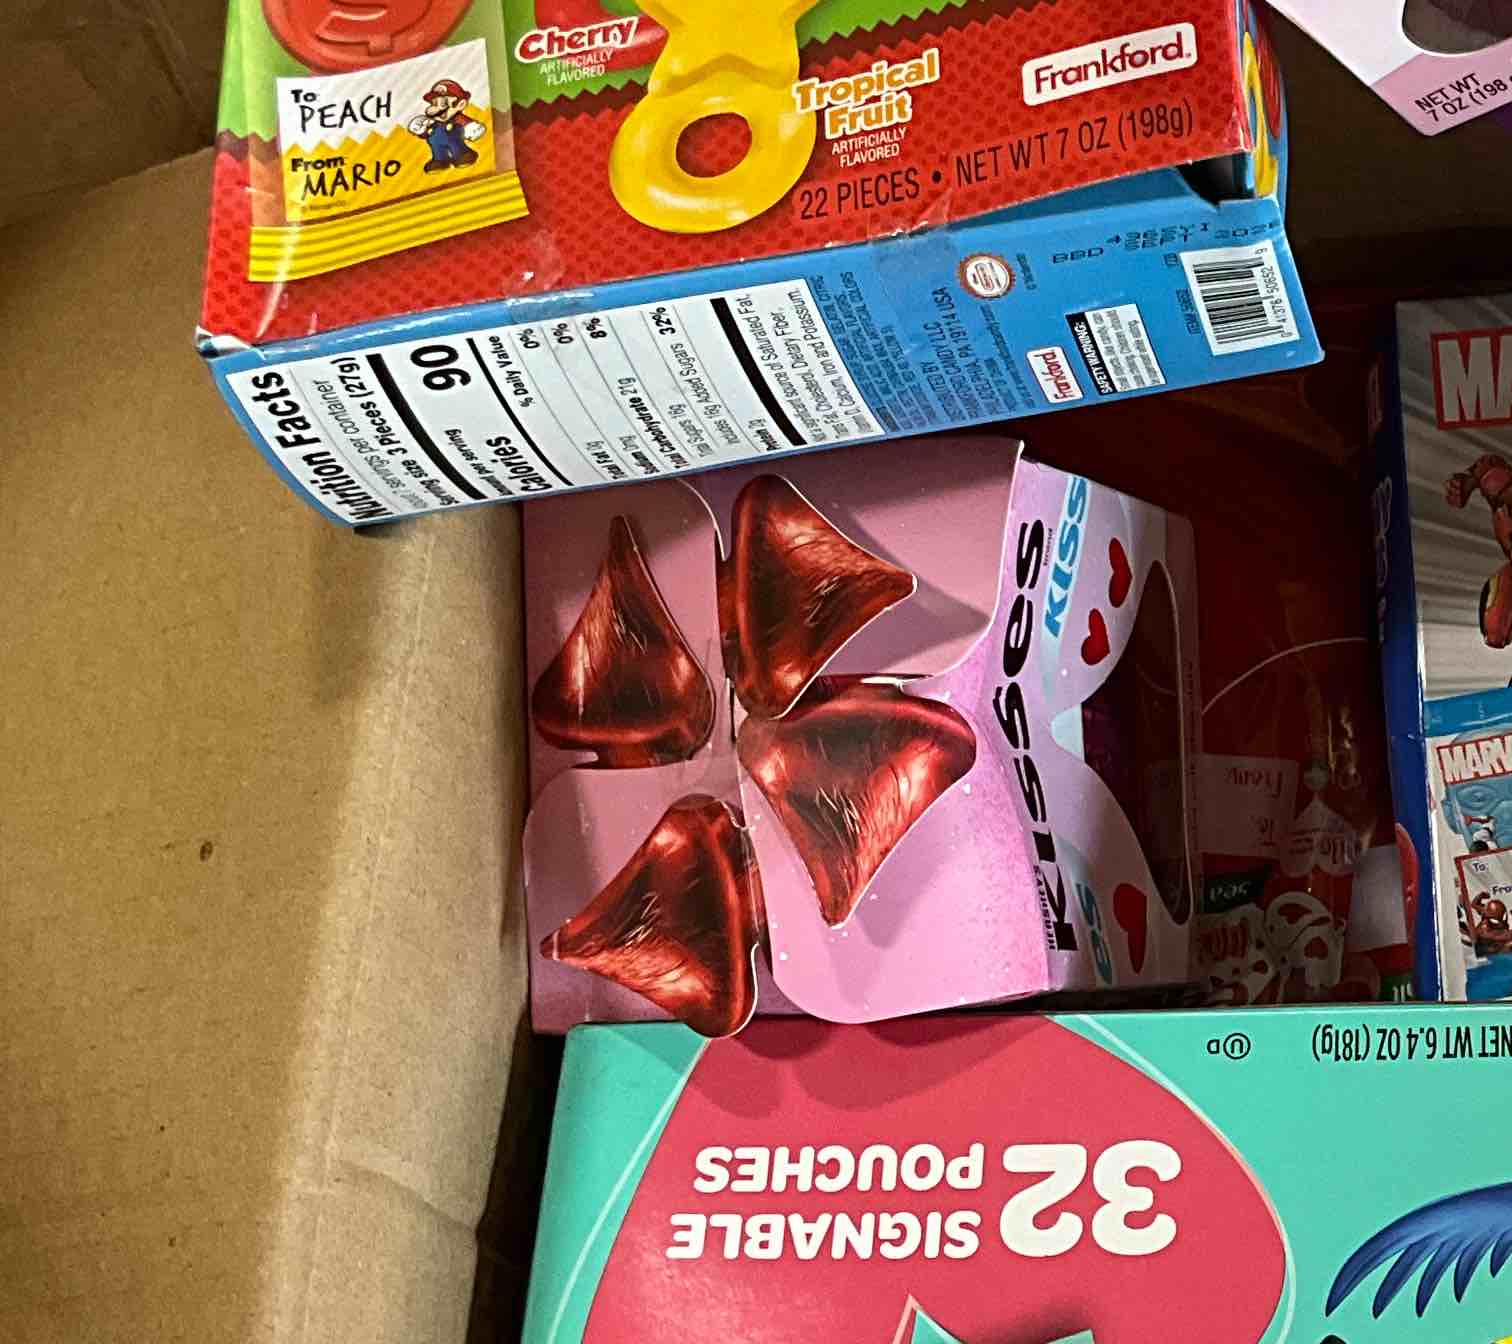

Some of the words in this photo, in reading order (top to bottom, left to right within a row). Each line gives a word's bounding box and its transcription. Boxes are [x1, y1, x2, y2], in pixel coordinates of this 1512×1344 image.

[517, 16, 639, 64] Cherry
[538, 46, 615, 75] ARTIFICIALLY
[546, 64, 606, 87] FLAVORED
[793, 47, 941, 115] Tropical
[1034, 31, 1186, 95] Frankford
[299, 91, 394, 133] PEACH
[1414, 86, 1450, 112] NET
[1451, 72, 1481, 96] WT
[1425, 108, 1440, 123] 7
[1441, 96, 1469, 116] OZ
[822, 90, 912, 140] Fruit
[800, 187, 829, 221] 22
[836, 168, 921, 212] PIECES
[956, 144, 1003, 189] NET
[1009, 133, 1050, 172] WT
[1056, 128, 1070, 161] 7
[1078, 117, 1111, 154] OZ
[1117, 96, 1195, 152] (198g)
[831, 126, 908, 157] ARTIFICIALLY
[839, 144, 901, 168] FLAVORED
[290, 156, 345, 173] From
[300, 159, 402, 201] MARIO
[410, 343, 472, 392] 90
[488, 335, 510, 369] Value
[329, 356, 376, 398] (27g)
[506, 368, 529, 400] Daily
[252, 371, 322, 449] Facts
[360, 400, 401, 450] Pieces
[301, 450, 394, 521] Nutrition
[485, 435, 554, 494] Calories
[1310, 1023, 1371, 1063] (181g)
[1376, 1027, 1402, 1061] OZ
[1404, 1026, 1439, 1060] 6.4
[1440, 1026, 1474, 1059] WT
[692, 1142, 985, 1194] POUCHES
[998, 1138, 1183, 1257] 32
[666, 1210, 981, 1260] SIGNABLE
